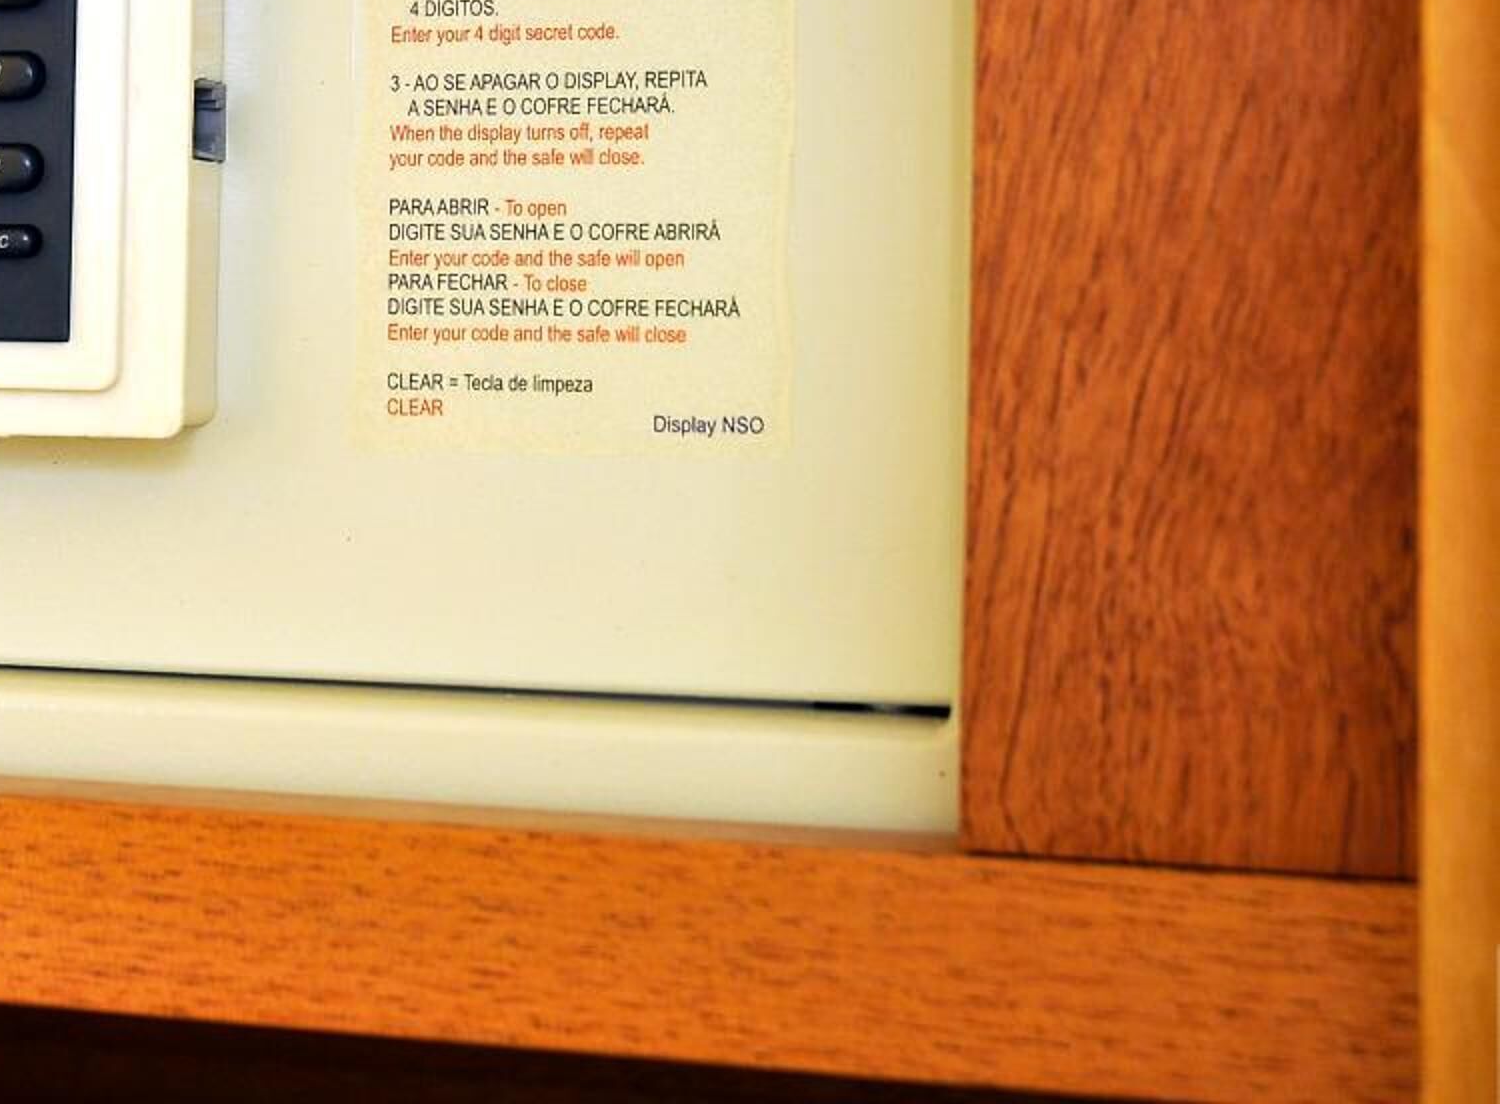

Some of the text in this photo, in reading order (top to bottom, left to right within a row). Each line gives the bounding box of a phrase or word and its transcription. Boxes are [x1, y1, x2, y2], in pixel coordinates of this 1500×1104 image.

[409, 0, 420, 17] 4
[391, 22, 620, 47] Enter your 4 digit secret code.
[391, 75, 400, 92] 3
[413, 74, 439, 92] AO
[444, 73, 467, 91] SE
[470, 72, 541, 92] APAGAR
[546, 72, 559, 90] O
[564, 71, 640, 92] DISPLAY,
[645, 70, 708, 89] REPITA
[408, 100, 420, 116] A
[424, 98, 483, 116] SENHA
[487, 98, 497, 115] E
[503, 97, 516, 116] O
[521, 96, 581, 115] COFRE
[390, 121, 649, 144] When the display turns off, repeat
[390, 146, 644, 169] your code and the safe will close.
[389, 197, 436, 216] PARA
[438, 197, 490, 216] ABRIR
[505, 199, 523, 217] To
[528, 202, 567, 220] open
[389, 218, 721, 241] DIGITE SUA SENHA E O COFRE ABRIRÁ
[389, 249, 684, 271] Enter your code and the safe will open
[388, 273, 433, 291] PARA
[438, 274, 507, 292] FECHAR
[524, 274, 542, 292] To
[547, 274, 587, 293] close
[388, 295, 740, 318] DIGITE SUA SENHA E O COFRE FECHARÁ
[388, 323, 686, 346] Enter your code and the safe will close
[387, 372, 444, 391] CLEAR
[464, 373, 503, 392] Tecla
[508, 374, 528, 392] de
[533, 374, 593, 396] limpeza
[387, 399, 444, 416] CLEAR
[653, 415, 764, 437] Display NSO
